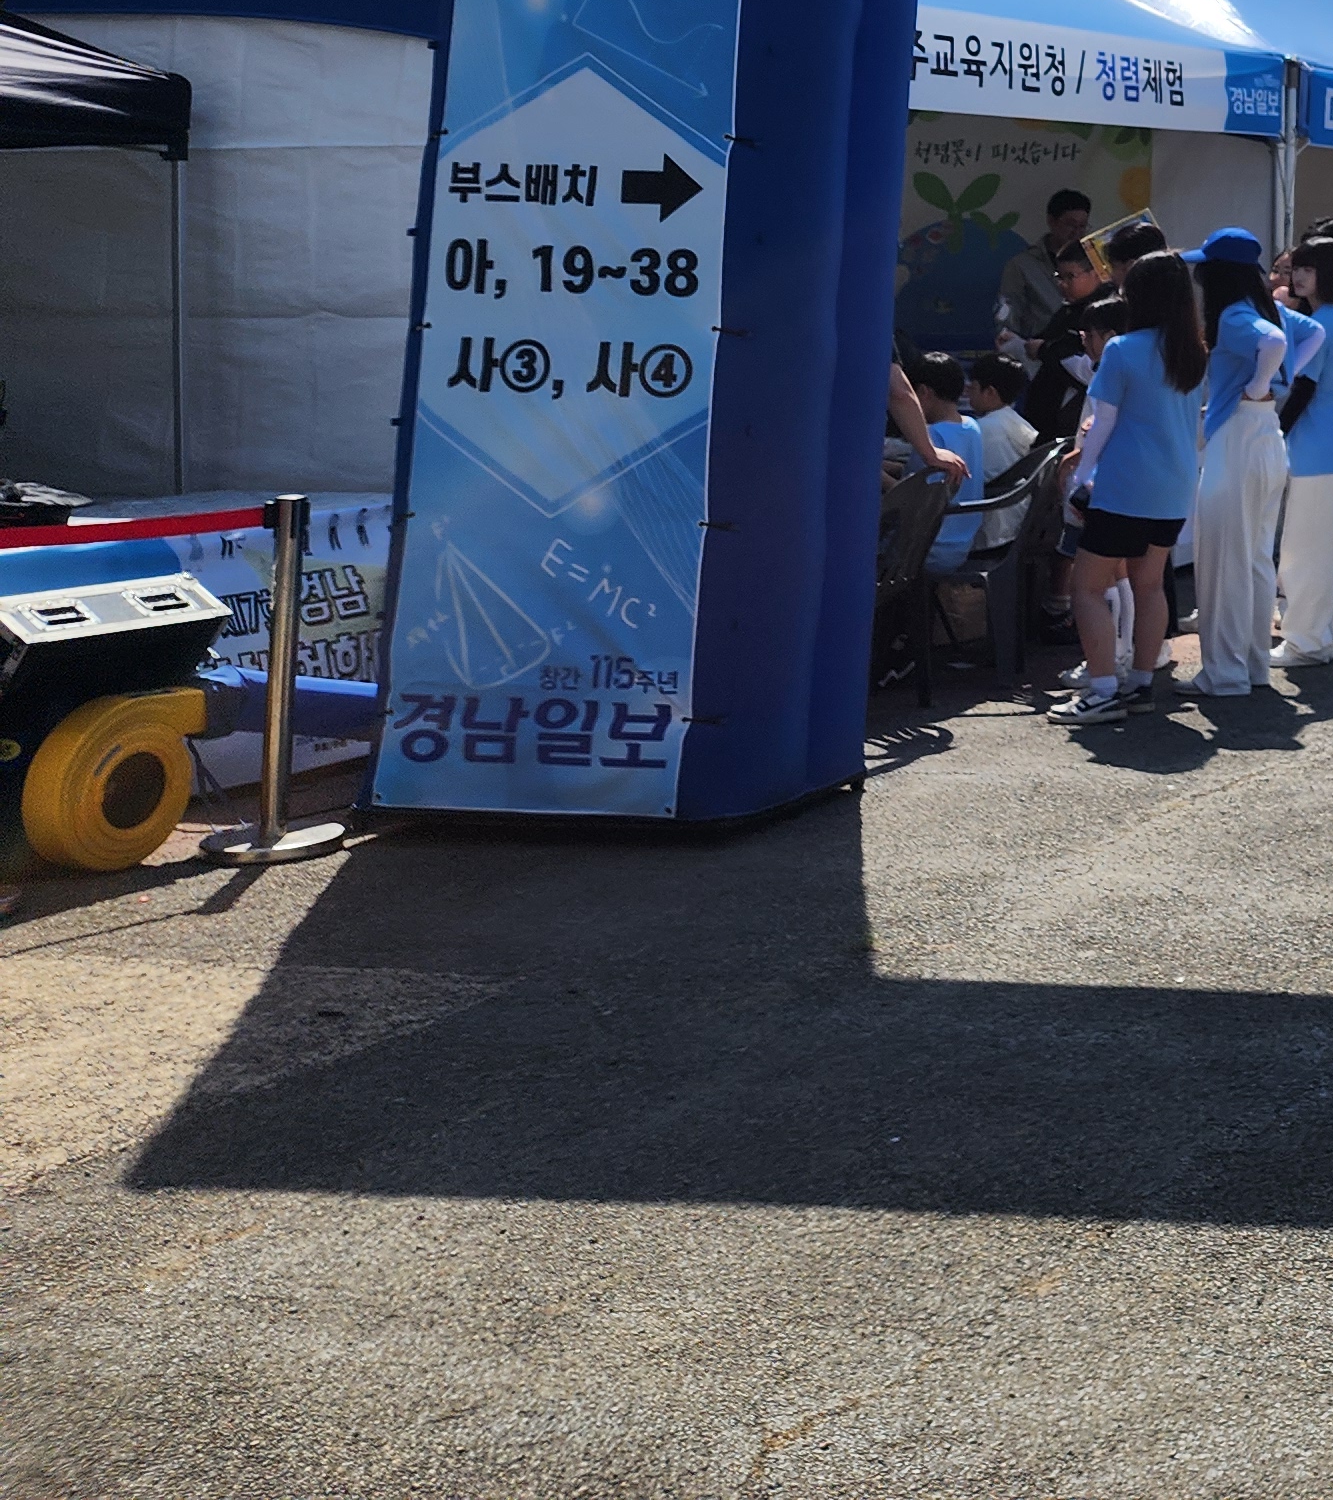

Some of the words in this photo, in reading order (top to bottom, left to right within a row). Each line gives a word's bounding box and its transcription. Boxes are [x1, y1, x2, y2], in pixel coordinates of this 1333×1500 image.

[1095, 51, 1185, 107] 청렴체험
[1229, 86, 1280, 117] 경남일보
[448, 162, 598, 206] 부스배치
[446, 238, 507, 299] 아,
[532, 244, 699, 297] 19~38
[540, 665, 583, 692] 창간
[589, 654, 680, 695] 115주년
[393, 692, 673, 769] 경남일보
